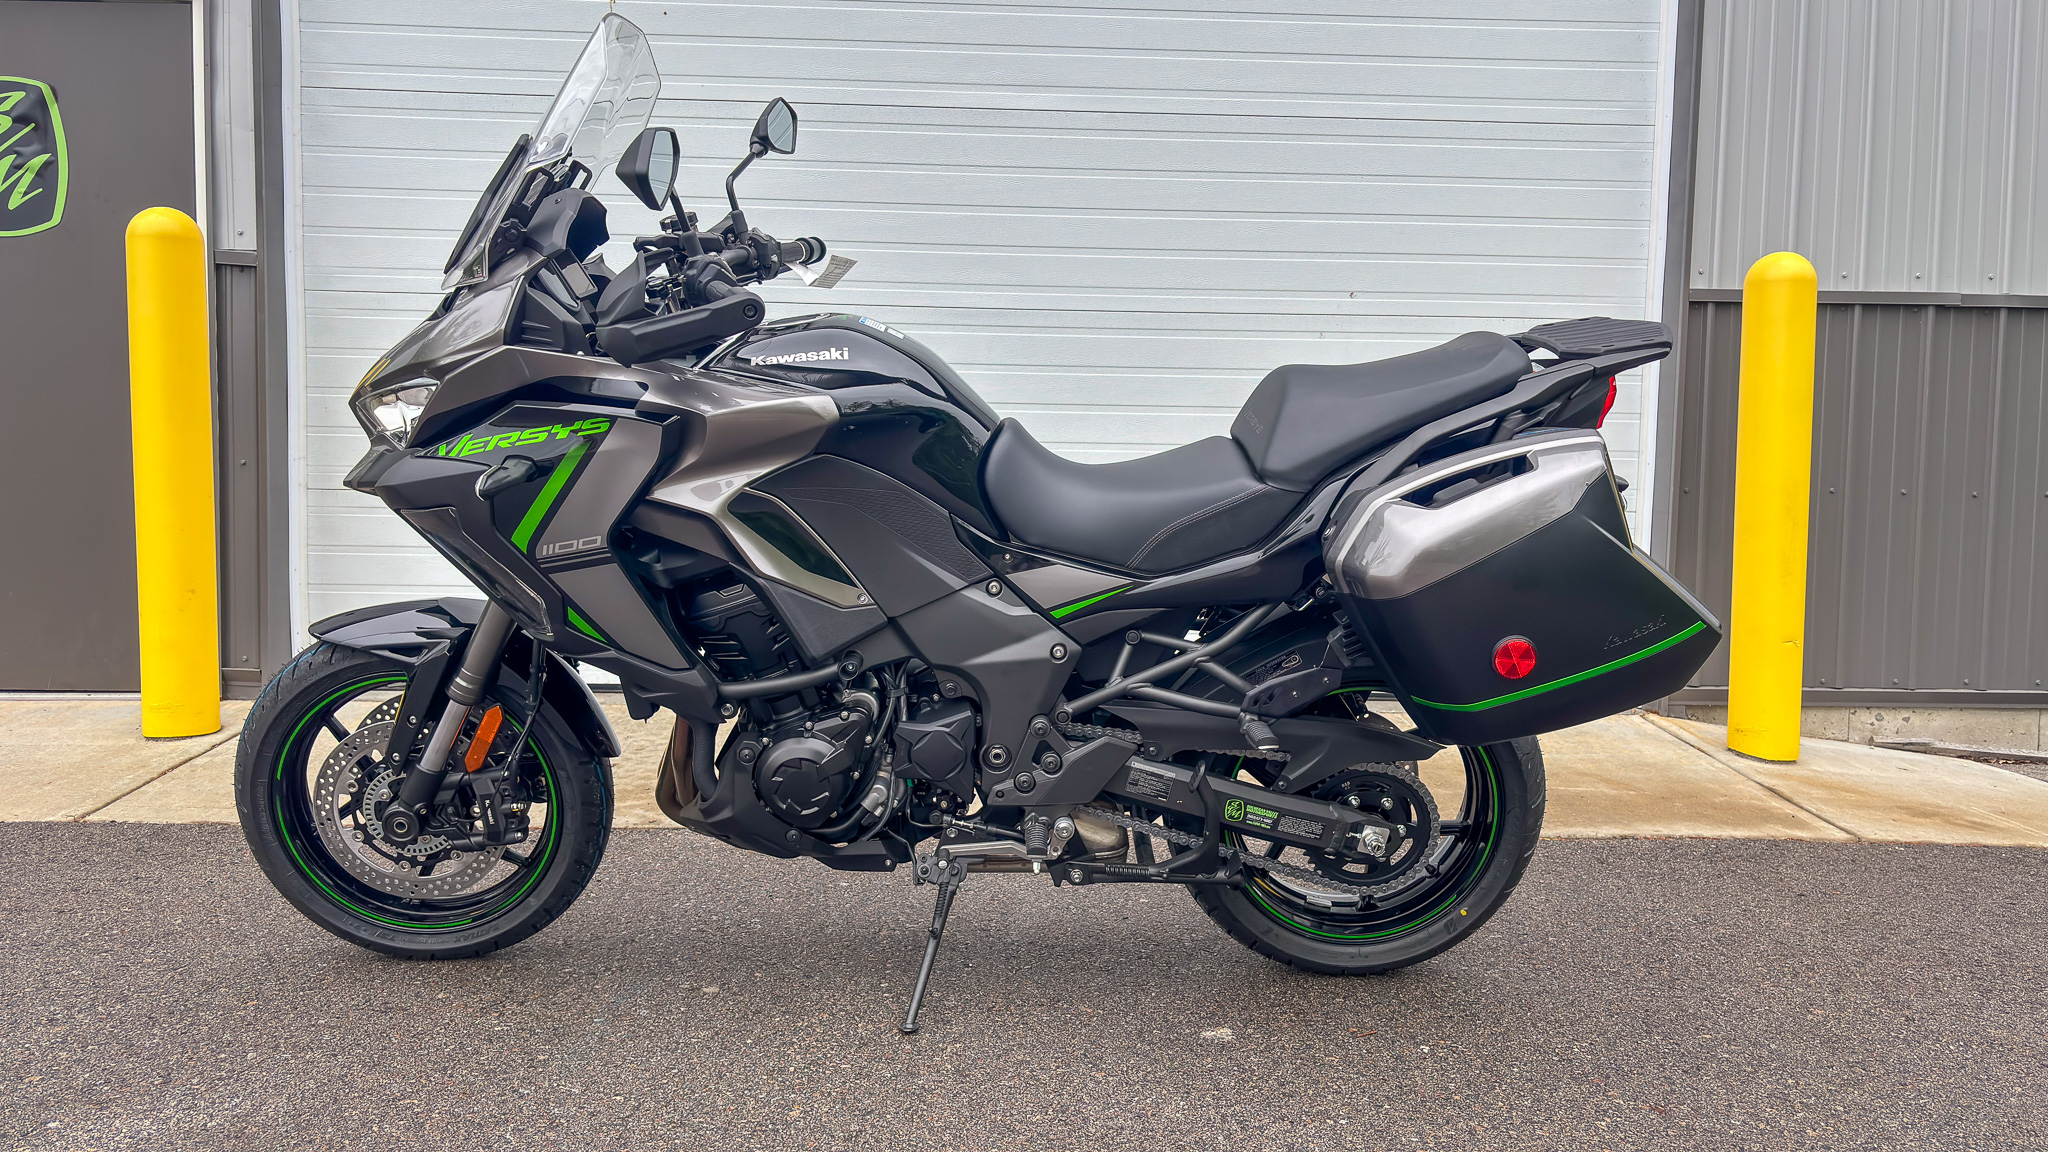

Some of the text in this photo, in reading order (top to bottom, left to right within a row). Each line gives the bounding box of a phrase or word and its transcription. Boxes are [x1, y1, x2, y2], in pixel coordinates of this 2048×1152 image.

[750, 347, 849, 367] Kawasaki
[438, 417, 611, 458] VERSYS
[542, 535, 602, 556] 1100
